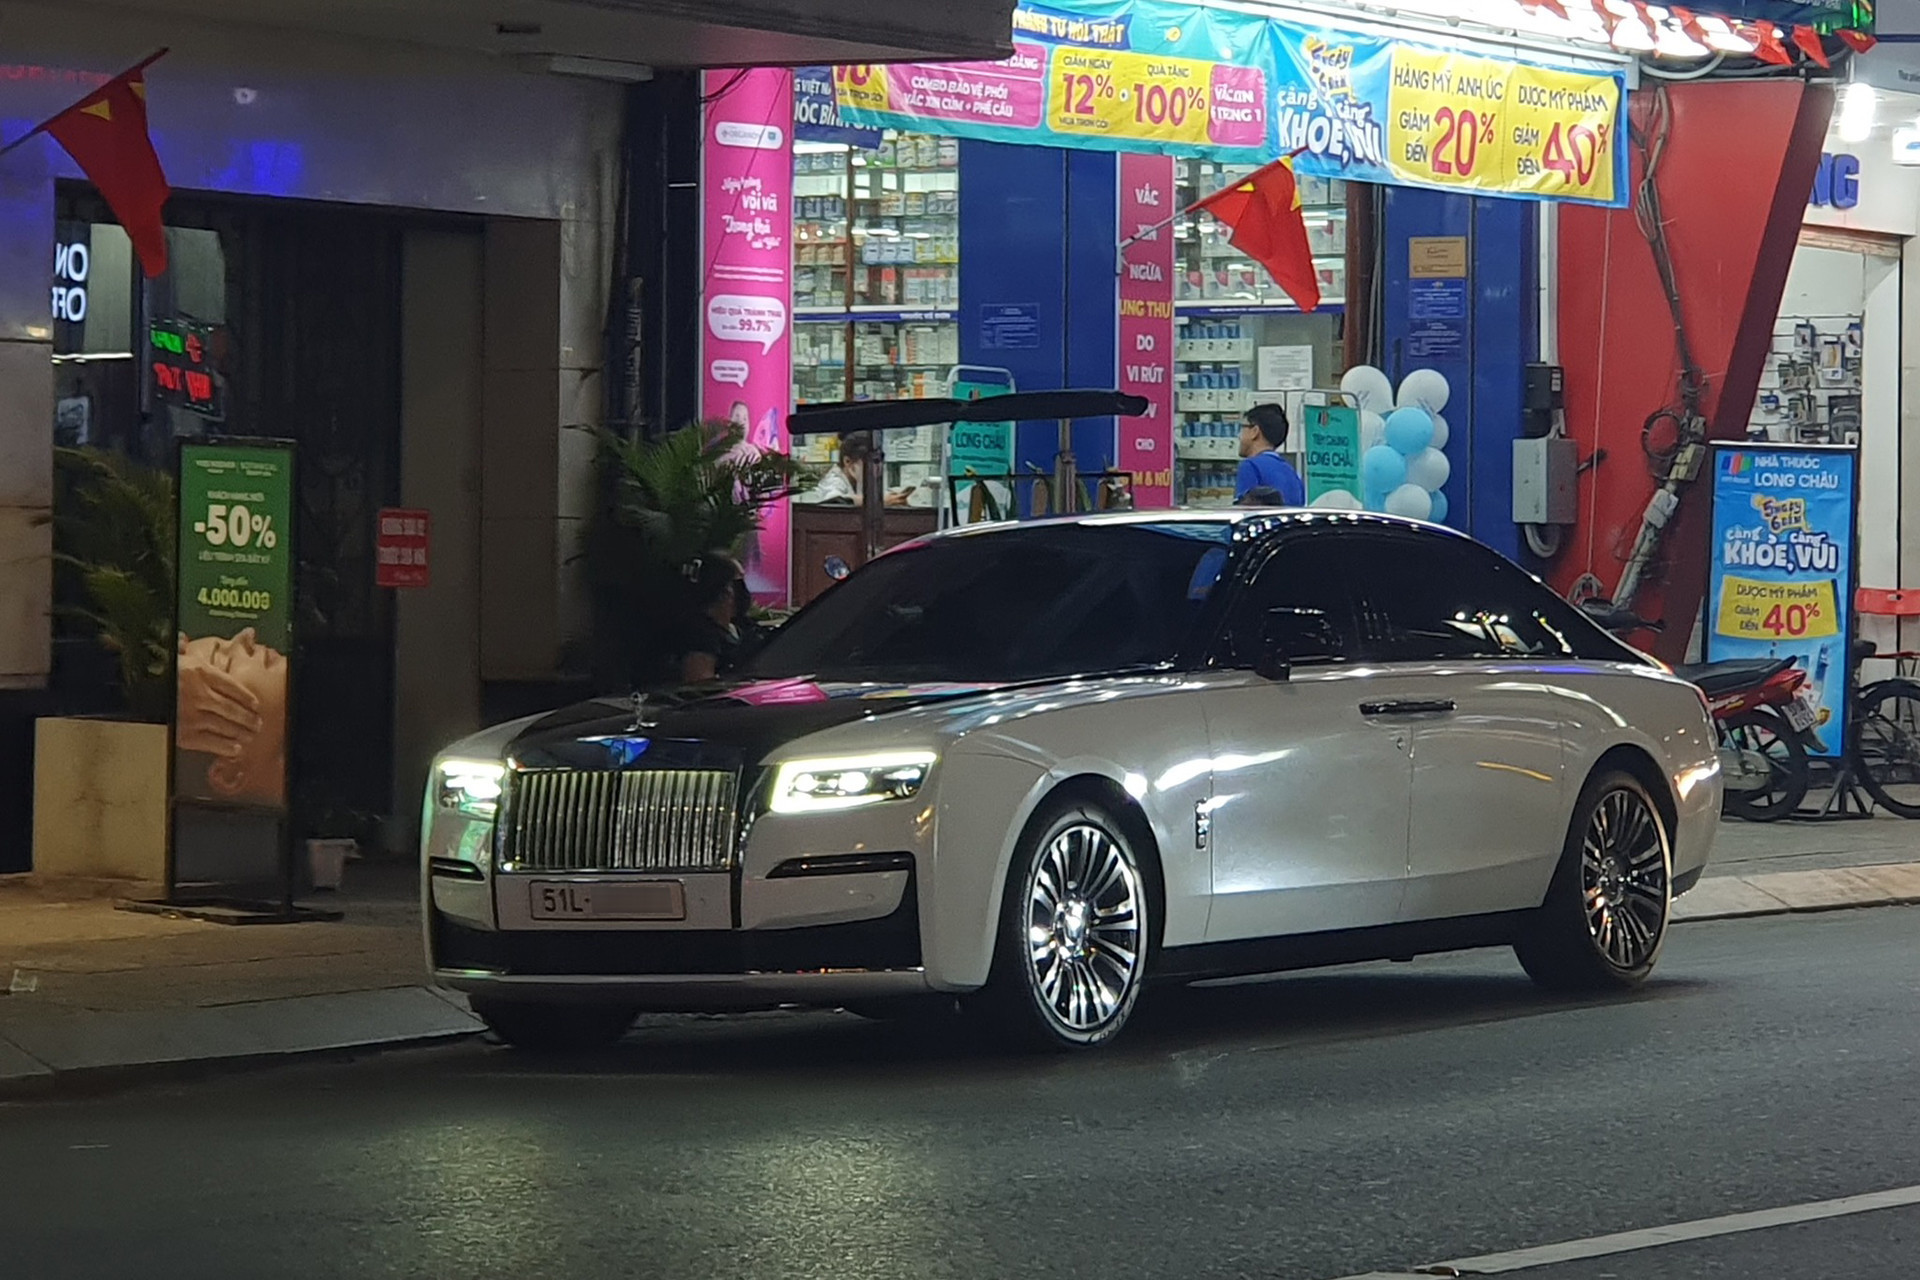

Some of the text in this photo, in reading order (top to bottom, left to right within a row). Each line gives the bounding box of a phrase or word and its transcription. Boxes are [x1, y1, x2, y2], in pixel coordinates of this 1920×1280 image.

[1063, 54, 1113, 70] GIẢM NGAY
[1147, 65, 1190, 80] QUÀ TẶNG
[802, 78, 821, 96] VIỆT
[911, 75, 947, 93] COMBO
[1394, 63, 1429, 90] HÀNG
[1486, 74, 1503, 101] ÚC
[1062, 72, 1114, 116] 12%
[1133, 83, 1205, 127] 100%
[1518, 85, 1608, 112] DƯỢC MỸ PHẨM
[1399, 108, 1430, 132] GIẢM
[1431, 106, 1497, 176] 20%
[1513, 122, 1540, 147] GIẢM
[1405, 137, 1428, 163] ĐẾN
[1542, 121, 1610, 186] 40%
[1517, 152, 1541, 175] ĐẾN
[1135, 182, 1159, 206] VẮC
[1129, 261, 1163, 282] NGỪA
[1136, 334, 1154, 351] DO
[1126, 363, 1165, 384] VI RÚT
[955, 431, 981, 450] LONG
[1135, 438, 1155, 451] CHO
[1754, 455, 1820, 469] NHÀ THUỐC
[1754, 473, 1796, 487] LONG
[1798, 470, 1839, 489] CHÂU
[194, 504, 276, 548] -50%
[1727, 524, 1764, 541] càng
[1789, 531, 1826, 548] càng
[1795, 545, 1837, 570] VUI
[1737, 583, 1818, 598] DƯỢC MỸ PHẨM
[1762, 602, 1820, 637] 40%
